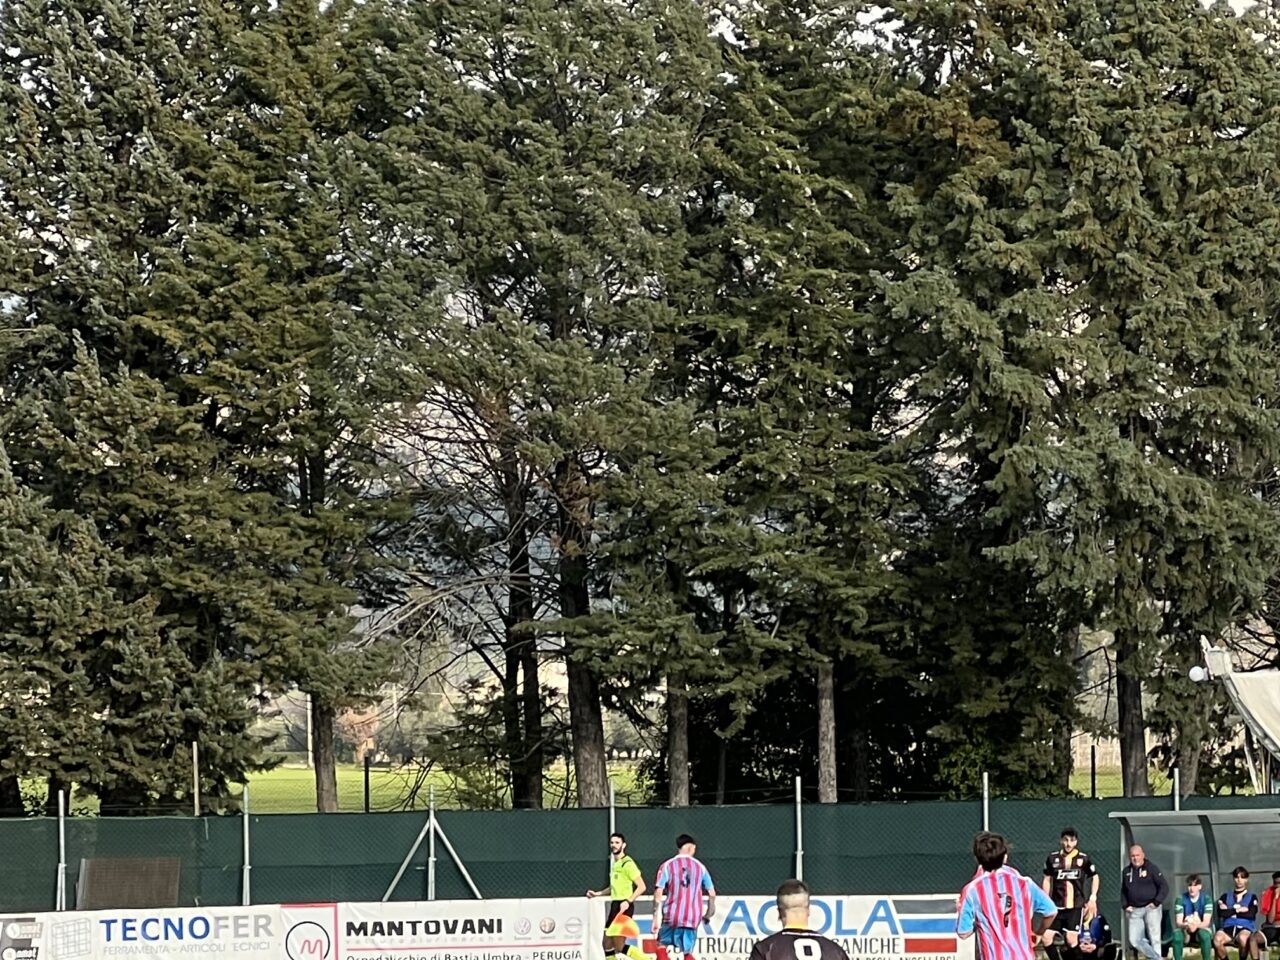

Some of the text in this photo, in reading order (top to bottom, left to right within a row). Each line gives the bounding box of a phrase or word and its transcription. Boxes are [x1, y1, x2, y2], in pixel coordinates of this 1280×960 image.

[99, 914, 274, 942] TECNOFER
[346, 919, 502, 936] MANTOVANI
[104, 945, 170, 955] FERRAMENTA
[228, 941, 270, 952] ECNICI
[666, 937, 761, 954] TRUZIO
[533, 950, 582, 960] PERUGIA
